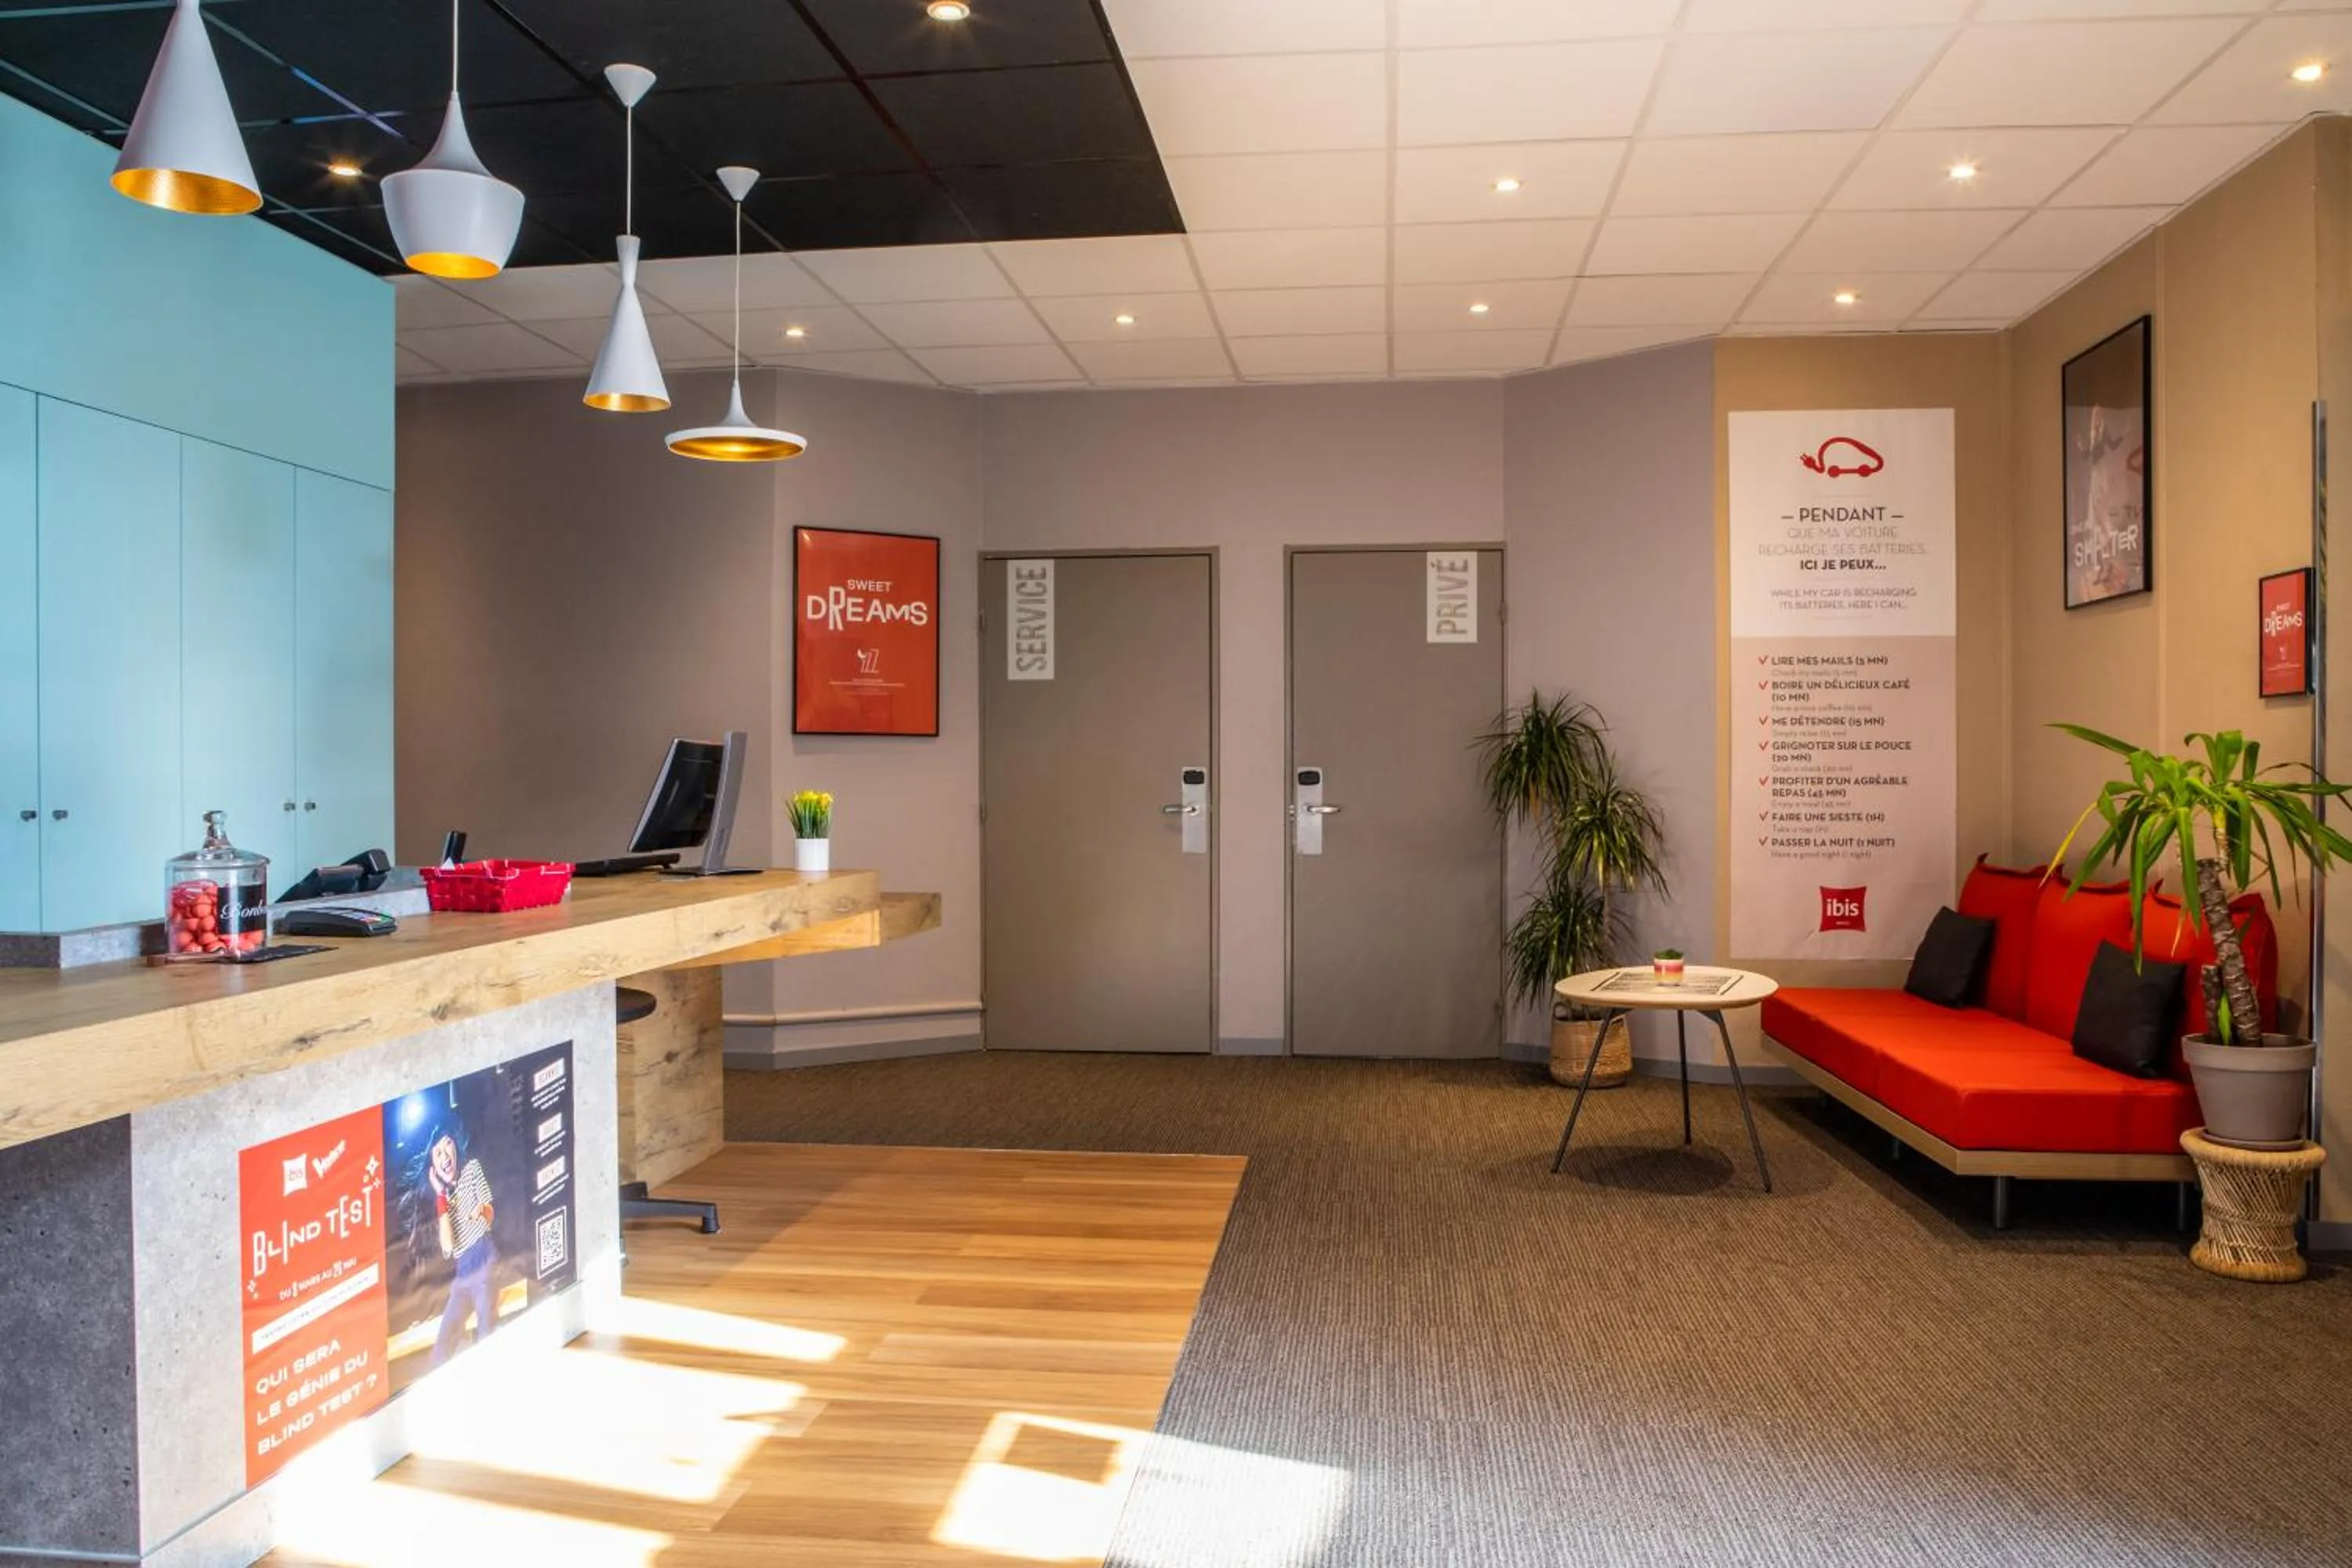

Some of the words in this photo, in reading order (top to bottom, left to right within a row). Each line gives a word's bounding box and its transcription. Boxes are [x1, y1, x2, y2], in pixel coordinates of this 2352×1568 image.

[1799, 506, 1887, 522] PENDANT
[1787, 527, 1815, 539] QUE
[1820, 527, 1840, 539] MA
[1844, 526, 1899, 539] VOITURE
[1800, 559, 1817, 570] ICI
[1822, 559, 1837, 570] JE
[1839, 558, 1888, 570] PEUX...
[848, 579, 893, 592] SWEET
[1430, 557, 1468, 636] PRIVÉ
[807, 586, 928, 631] DREAMS
[1015, 566, 1047, 672] SERVICE
[2264, 611, 2303, 637] DREAMS
[1771, 656, 1794, 666] LIRE
[1797, 656, 1819, 666] MES
[1821, 656, 1853, 666] MAILS
[1771, 681, 1803, 689] BOIRE
[1806, 681, 1821, 689] UN
[1824, 677, 1880, 689] DÉLICIEUX
[1882, 677, 1911, 689] CAFÉ
[1788, 693, 1810, 702] MN)
[1771, 717, 1788, 726] ME
[1790, 715, 1846, 726] DÉTENDRE
[1864, 717, 1885, 727] MN)
[1772, 741, 1835, 750] GRIGNOTER
[1837, 741, 1857, 750] SUR
[1859, 741, 1873, 750] LE
[1875, 741, 1913, 750] POUCE
[1772, 776, 1824, 785] PROFITER
[1825, 776, 1851, 785] D'UN
[1853, 773, 1908, 786] AGRÉABLE
[1772, 788, 1806, 797] REPAS
[1772, 812, 1802, 822] FAIRE
[1804, 812, 1826, 822] UNE
[1828, 812, 1864, 822] SIESTE
[1771, 838, 1811, 847] PASSER
[1813, 838, 1827, 847] LA
[1830, 838, 1854, 847] NUIT
[1867, 837, 1896, 848] NUIT)
[1826, 897, 1860, 916] ibis
[252, 1219, 321, 1278] BLIND
[325, 1185, 373, 1238] TEST
[256, 1367, 289, 1395] QUI
[292, 1339, 342, 1374] SERA
[256, 1399, 282, 1427] LE
[286, 1366, 340, 1408] GÉNIE
[343, 1348, 368, 1374] DU
[257, 1412, 314, 1456] BLIND
[318, 1381, 364, 1417] TEST
[366, 1374, 378, 1388] ?
